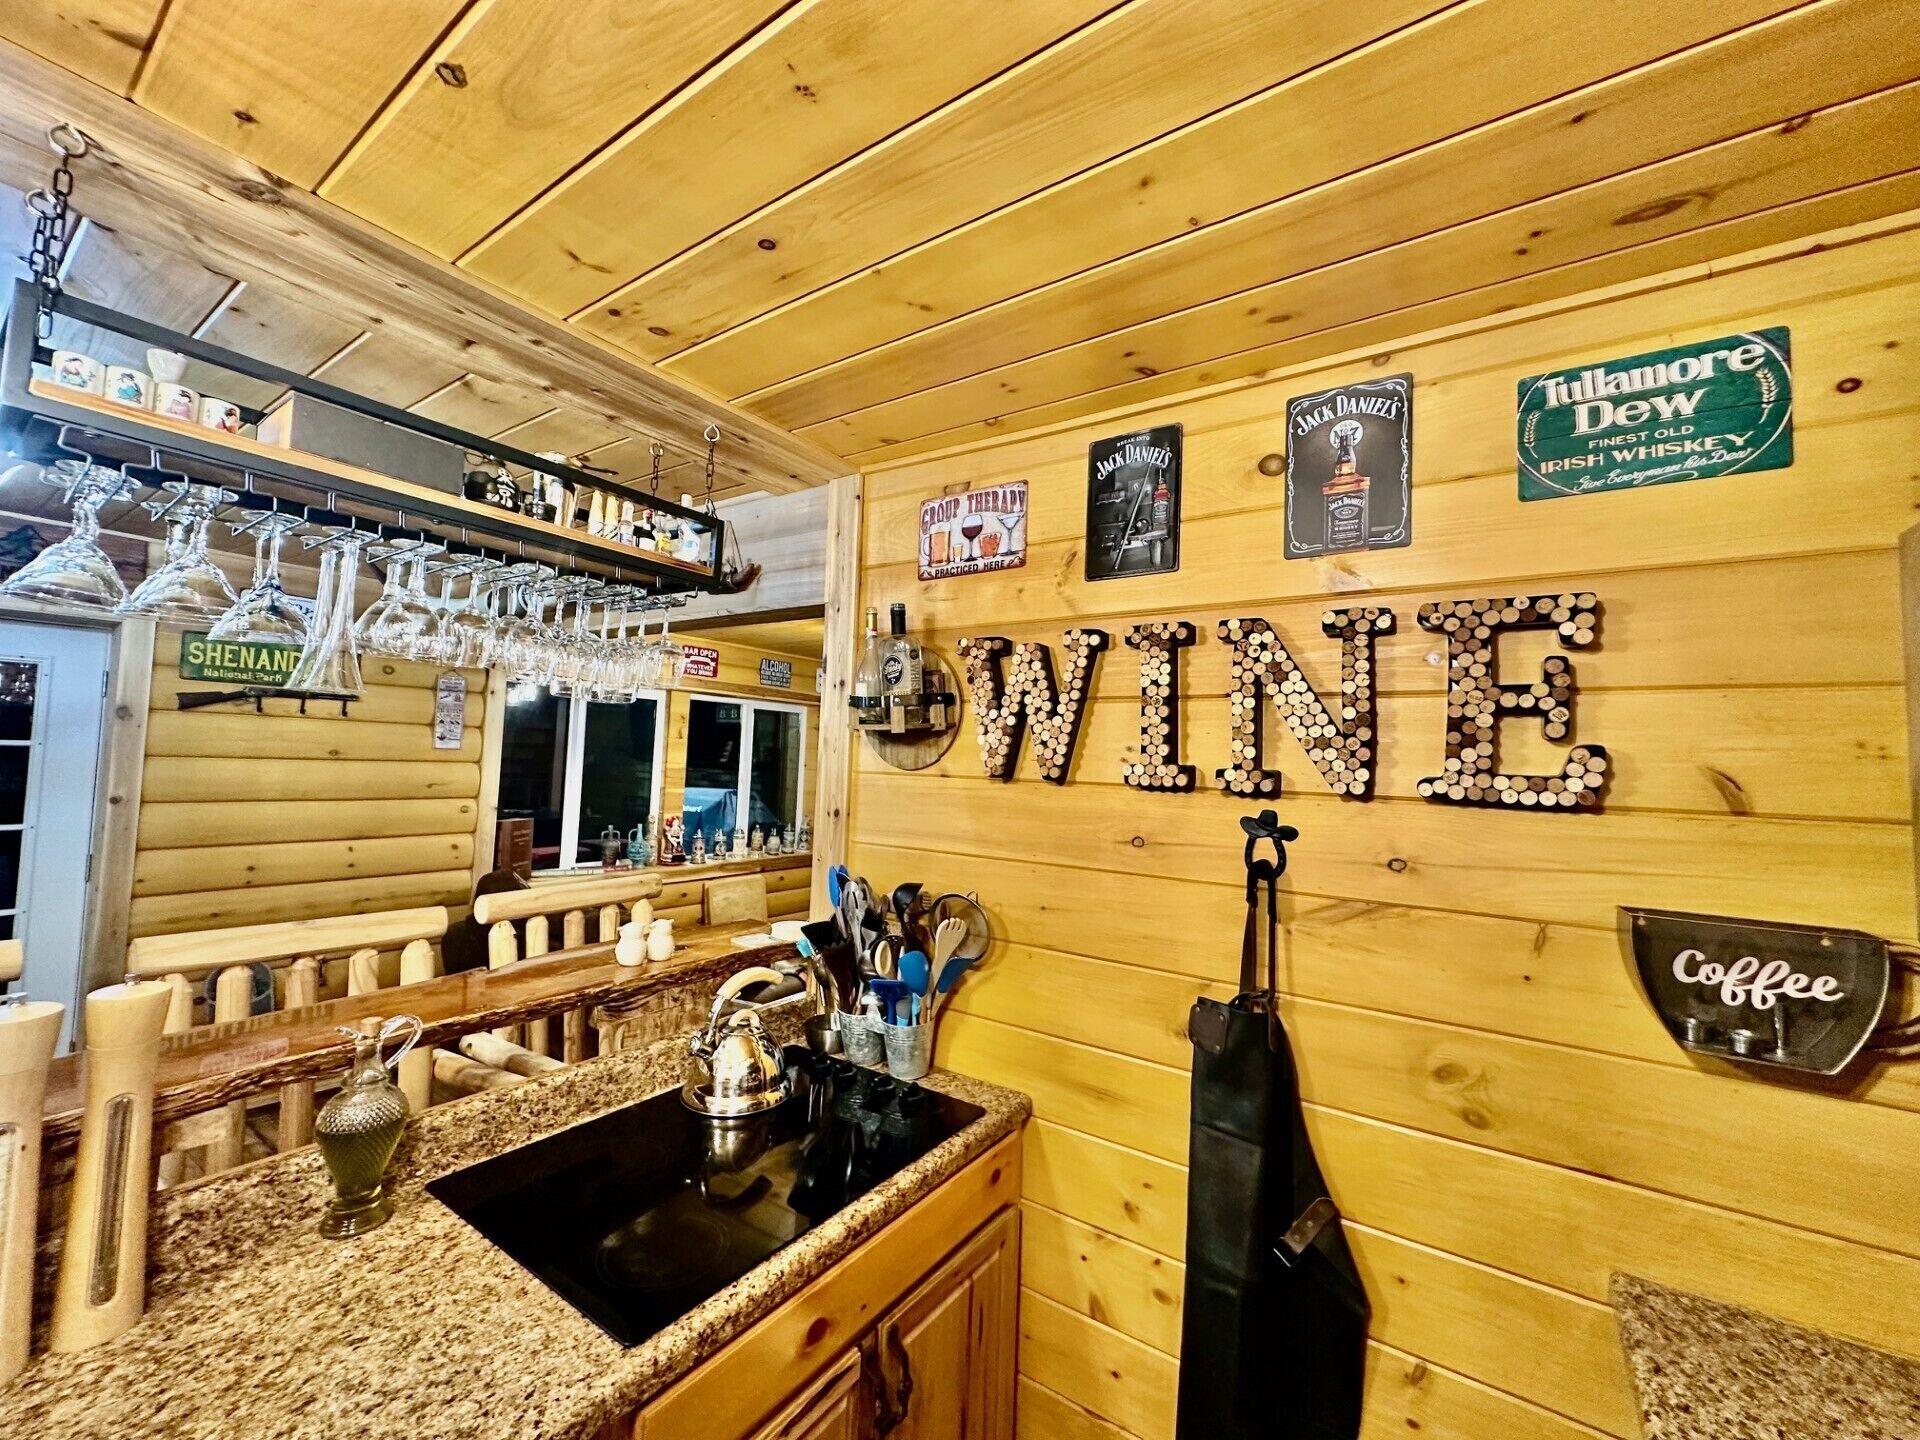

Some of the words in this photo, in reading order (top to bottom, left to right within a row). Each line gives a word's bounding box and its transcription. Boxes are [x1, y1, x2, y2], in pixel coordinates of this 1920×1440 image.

[1537, 343, 1766, 410] Tullamore
[1296, 403, 1336, 436] JACK
[1588, 431, 1646, 449] FINEST
[1654, 425, 1694, 439] OLD
[1096, 450, 1125, 480] JACK
[1540, 453, 1605, 475] IRISH
[1611, 431, 1756, 463] WHISKEY
[1708, 447, 1753, 464] Dew
[921, 497, 960, 535] GROUP
[967, 489, 1026, 514] THERAPY
[934, 563, 979, 578] PRACTICED
[983, 560, 1006, 570] HERE
[684, 646, 699, 656] BAR
[700, 649, 717, 659] OPEN
[761, 659, 791, 674] ALCOHOL
[956, 592, 1608, 812] WINE
[1672, 949, 1844, 1011] Coffee
